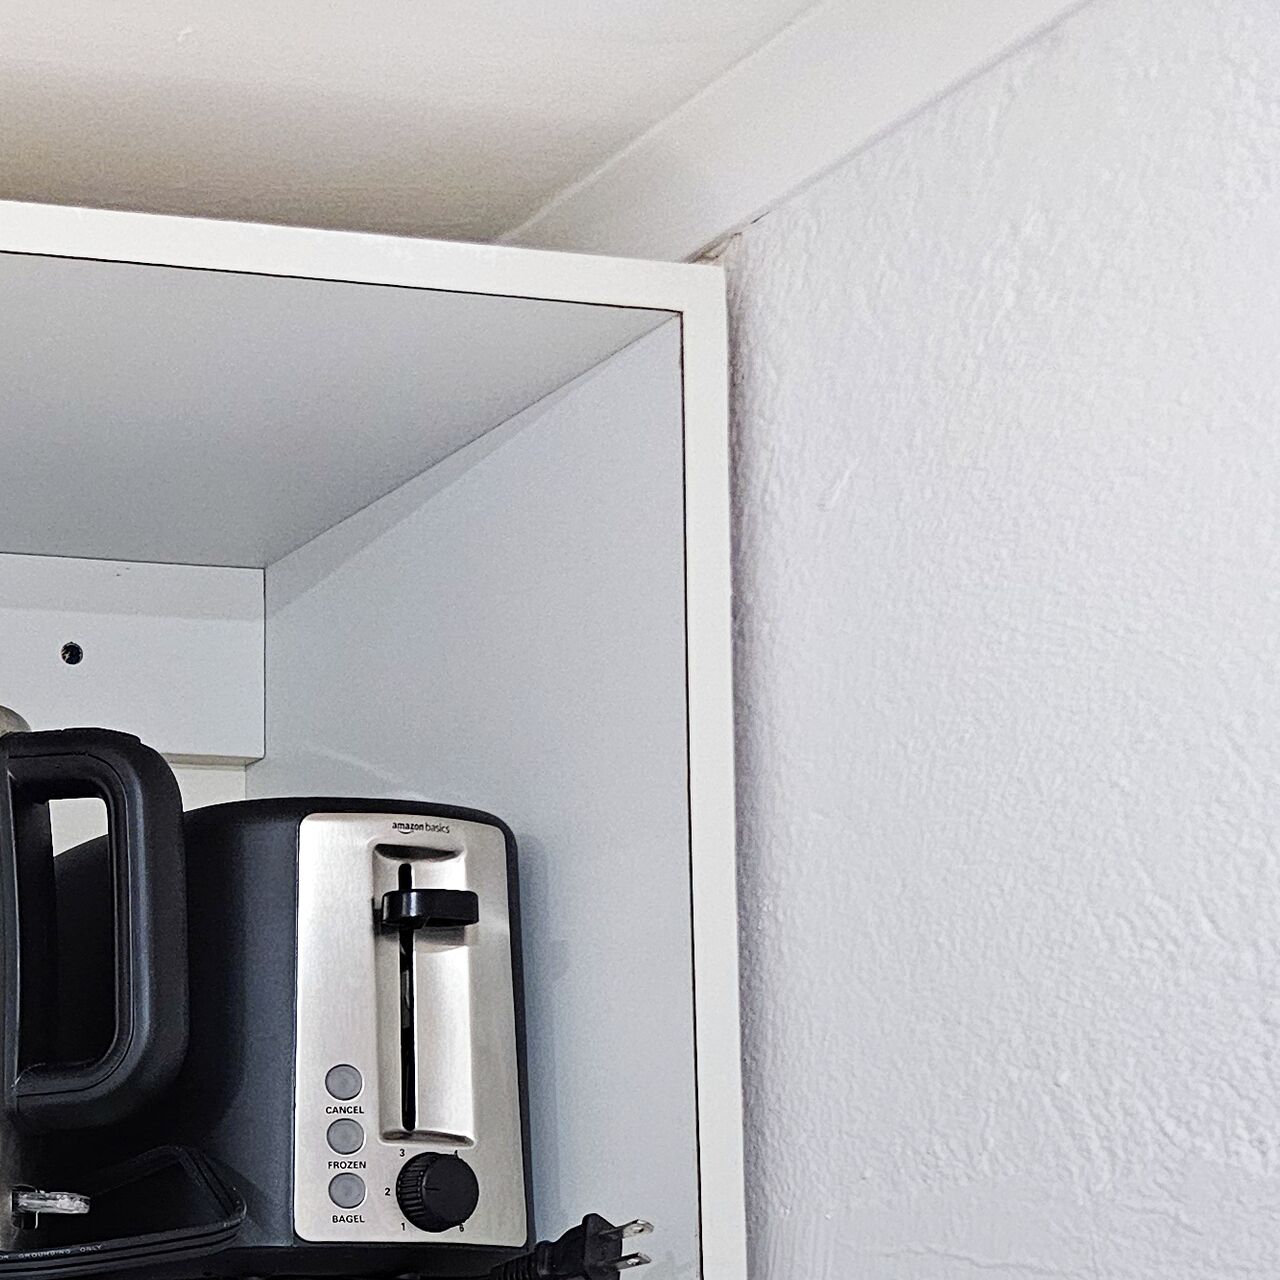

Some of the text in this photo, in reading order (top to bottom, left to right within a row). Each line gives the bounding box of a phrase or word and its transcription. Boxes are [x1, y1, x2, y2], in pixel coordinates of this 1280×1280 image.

[392, 822, 450, 833] amazon basics
[326, 1106, 364, 1114] CANCEL
[328, 1161, 366, 1169] FROZEN
[385, 1188, 390, 1196] 2
[332, 1215, 365, 1223] BAGEL
[19, 1249, 71, 1258] GROUNDING
[80, 1244, 102, 1253] ONLY
